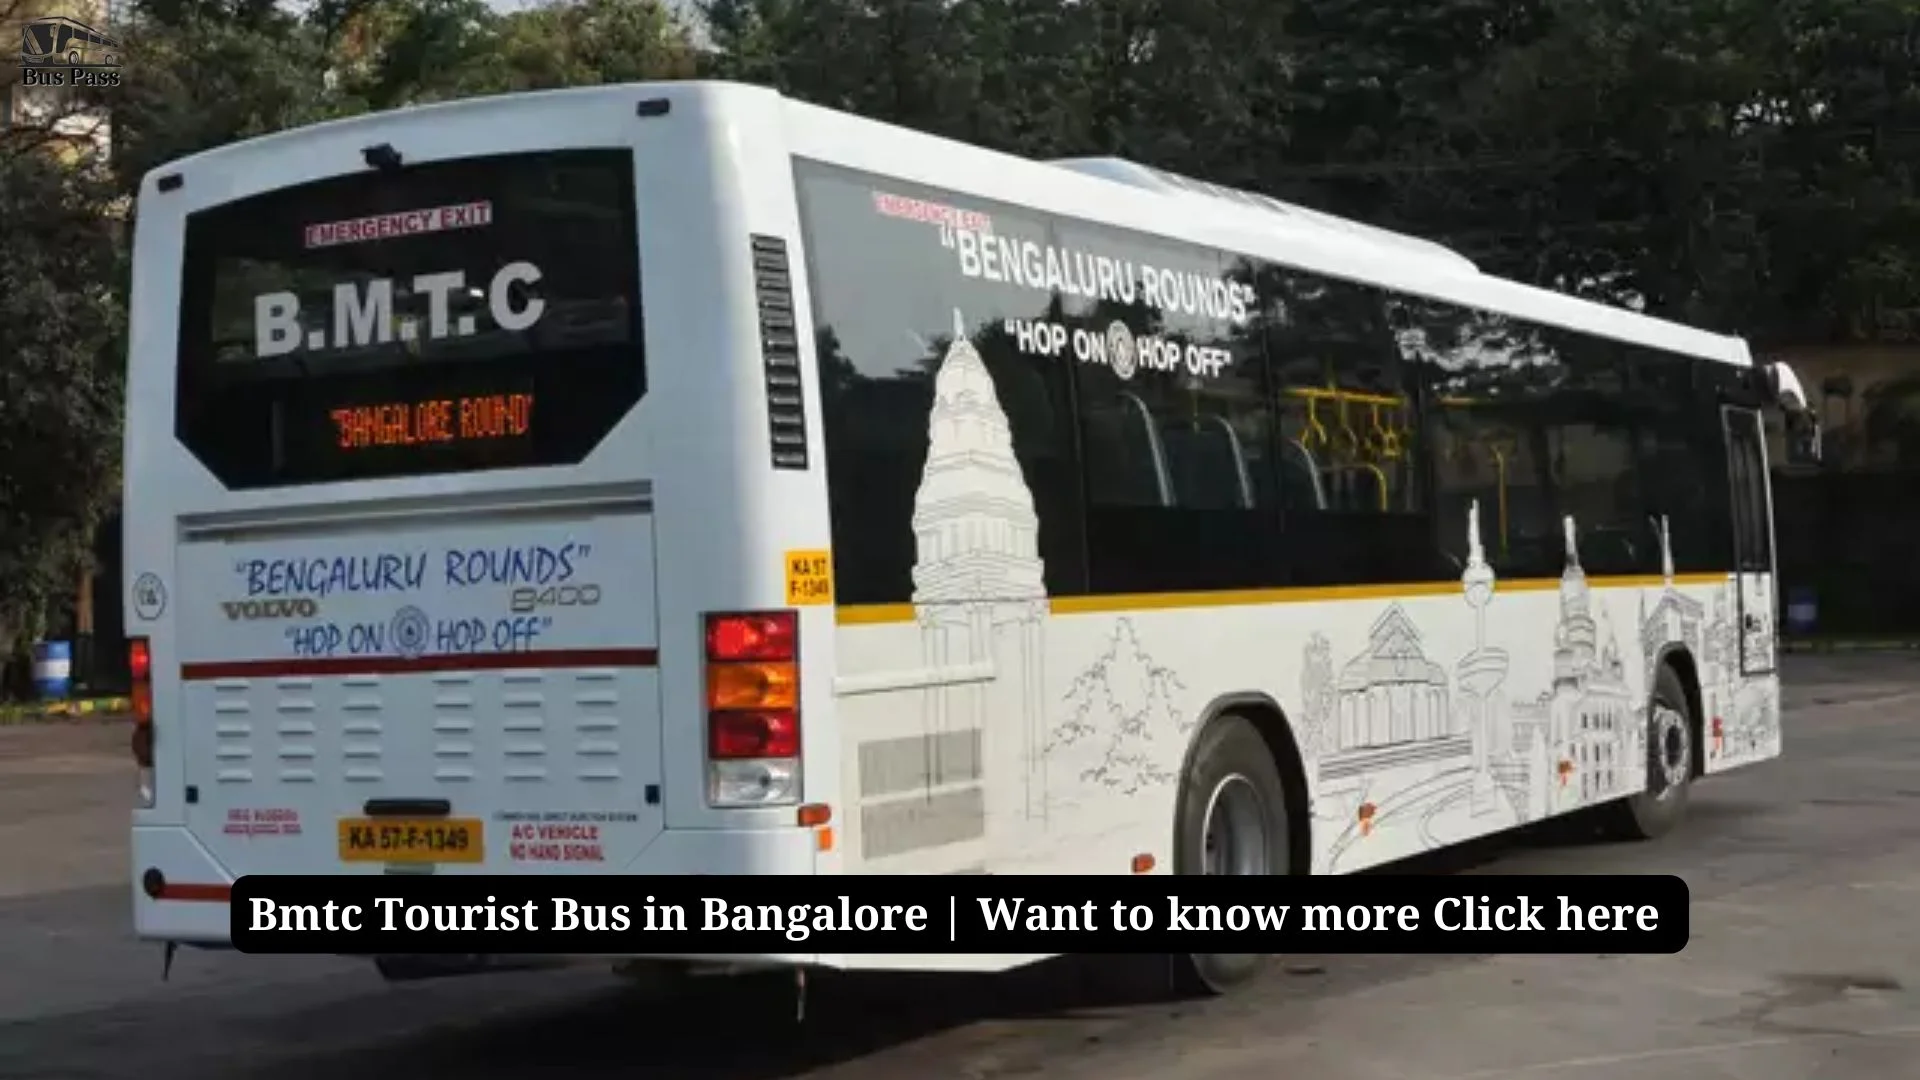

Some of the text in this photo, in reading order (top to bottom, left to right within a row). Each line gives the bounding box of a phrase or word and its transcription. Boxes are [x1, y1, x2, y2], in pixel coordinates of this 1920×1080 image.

[305, 202, 491, 247] EMERGENCY EXIT
[1073, 330, 1107, 366] ON
[1137, 334, 1180, 372] HOP
[791, 557, 827, 577] KA 57
[221, 598, 318, 620] VOLVO
[347, 622, 384, 652] ON
[437, 619, 486, 652] HOP
[349, 825, 375, 850] KA
[537, 824, 599, 840] VEHICLE
